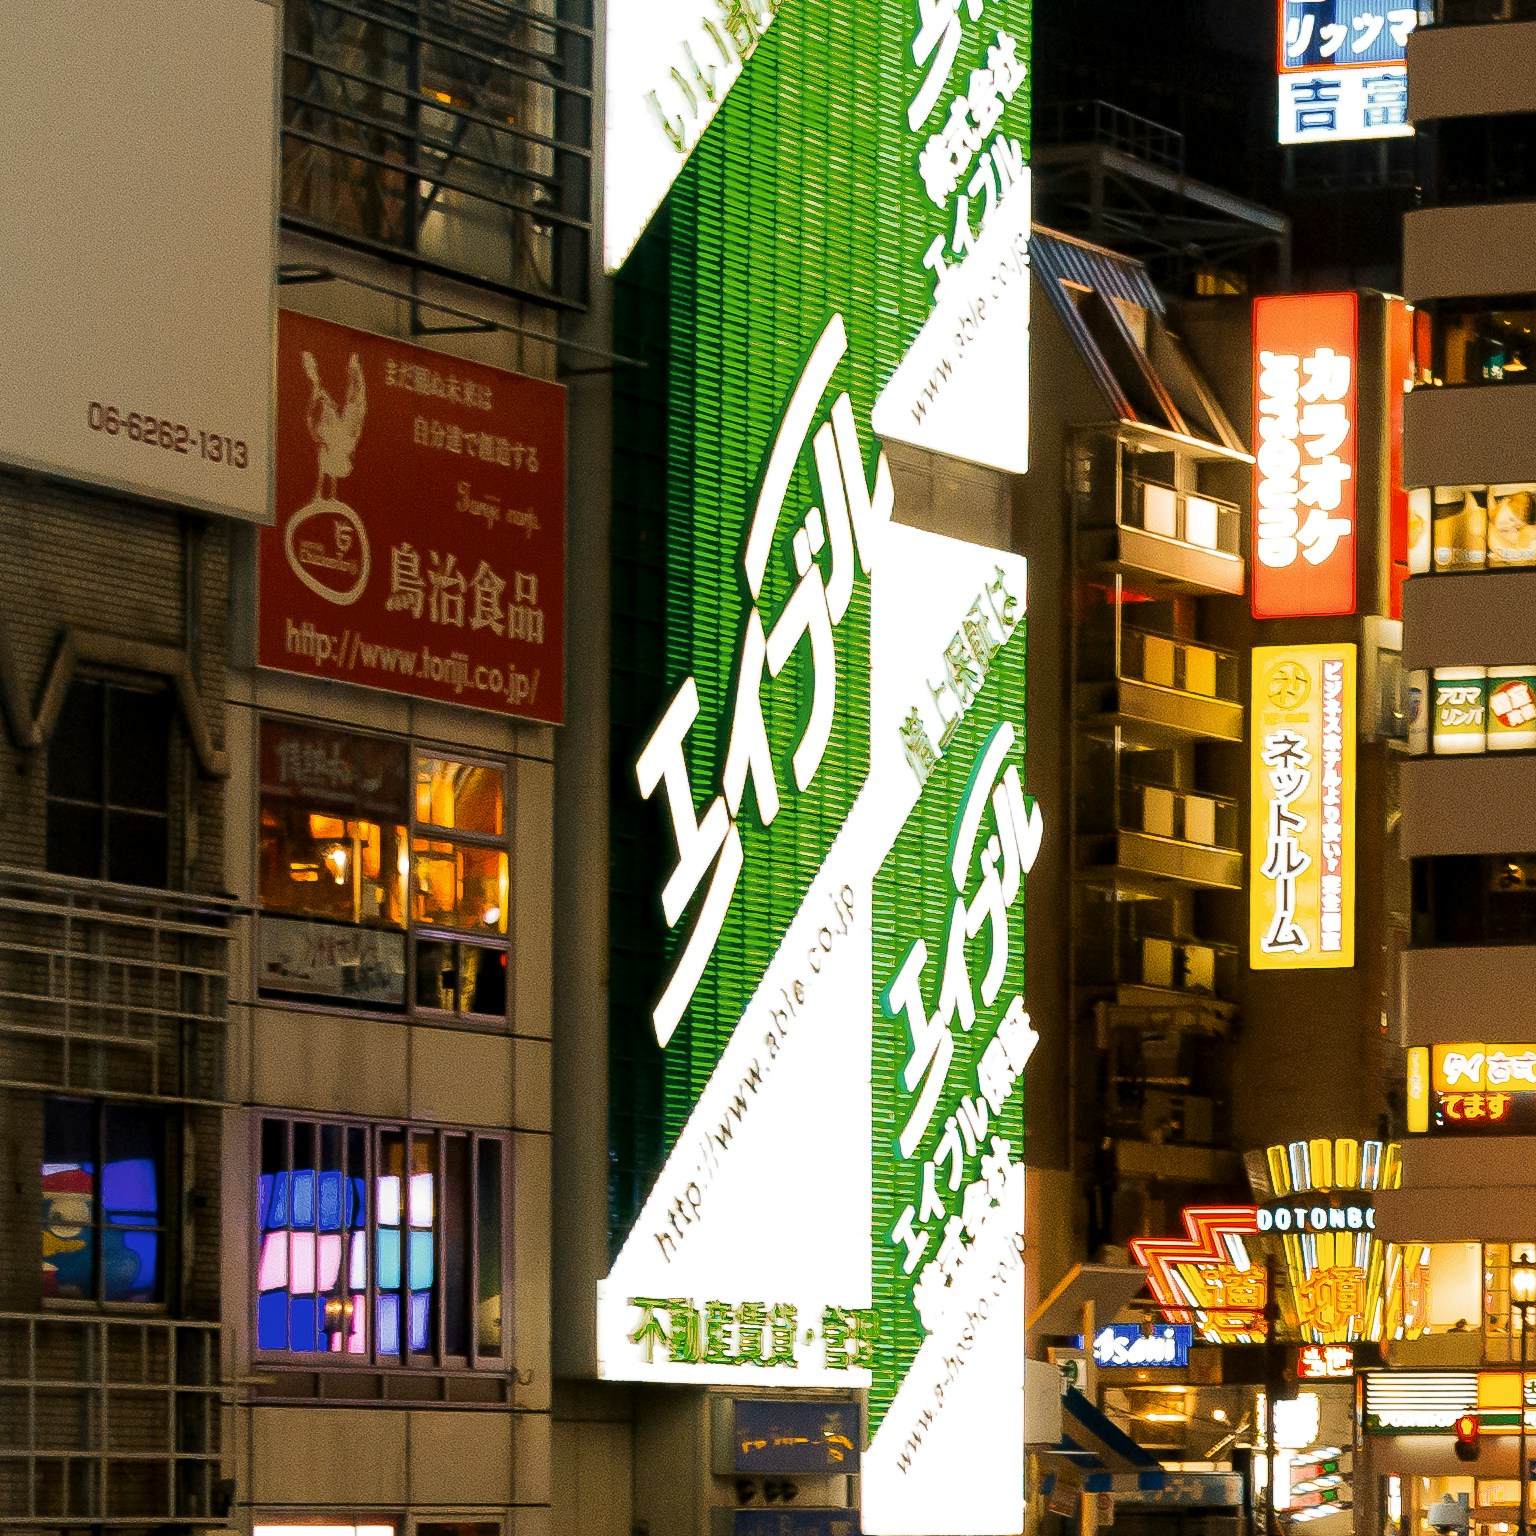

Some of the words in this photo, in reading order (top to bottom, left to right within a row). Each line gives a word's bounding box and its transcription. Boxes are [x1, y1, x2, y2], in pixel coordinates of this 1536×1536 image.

[88, 401, 249, 469] 06-6262-1313
[1299, 348, 1351, 565] カラオケ
[386, 541, 544, 644] 鳥治食品
[1262, 733, 1309, 953] ネットルーム
[1442, 1093, 1512, 1120] てます
